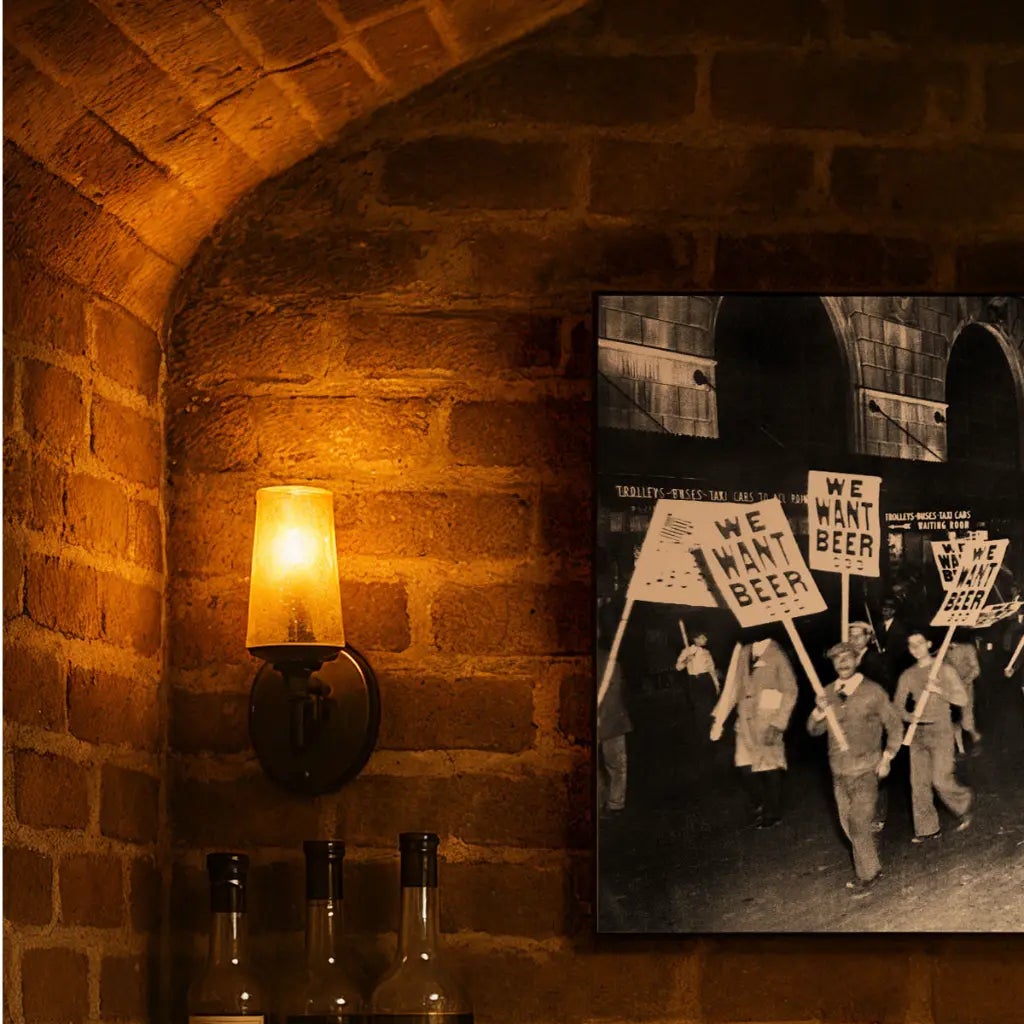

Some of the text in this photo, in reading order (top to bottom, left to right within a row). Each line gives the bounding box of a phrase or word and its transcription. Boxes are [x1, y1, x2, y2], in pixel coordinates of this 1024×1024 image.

[826, 477, 863, 498] WE
[714, 510, 766, 539] WE
[815, 497, 873, 531] WANT
[918, 521, 969, 530] WAITING ROOM
[712, 532, 789, 580] WANT
[816, 529, 874, 557] BEER
[973, 545, 998, 561] WE
[956, 563, 998, 588] WANT
[729, 571, 808, 607] BEER
[944, 590, 985, 611] BEER
